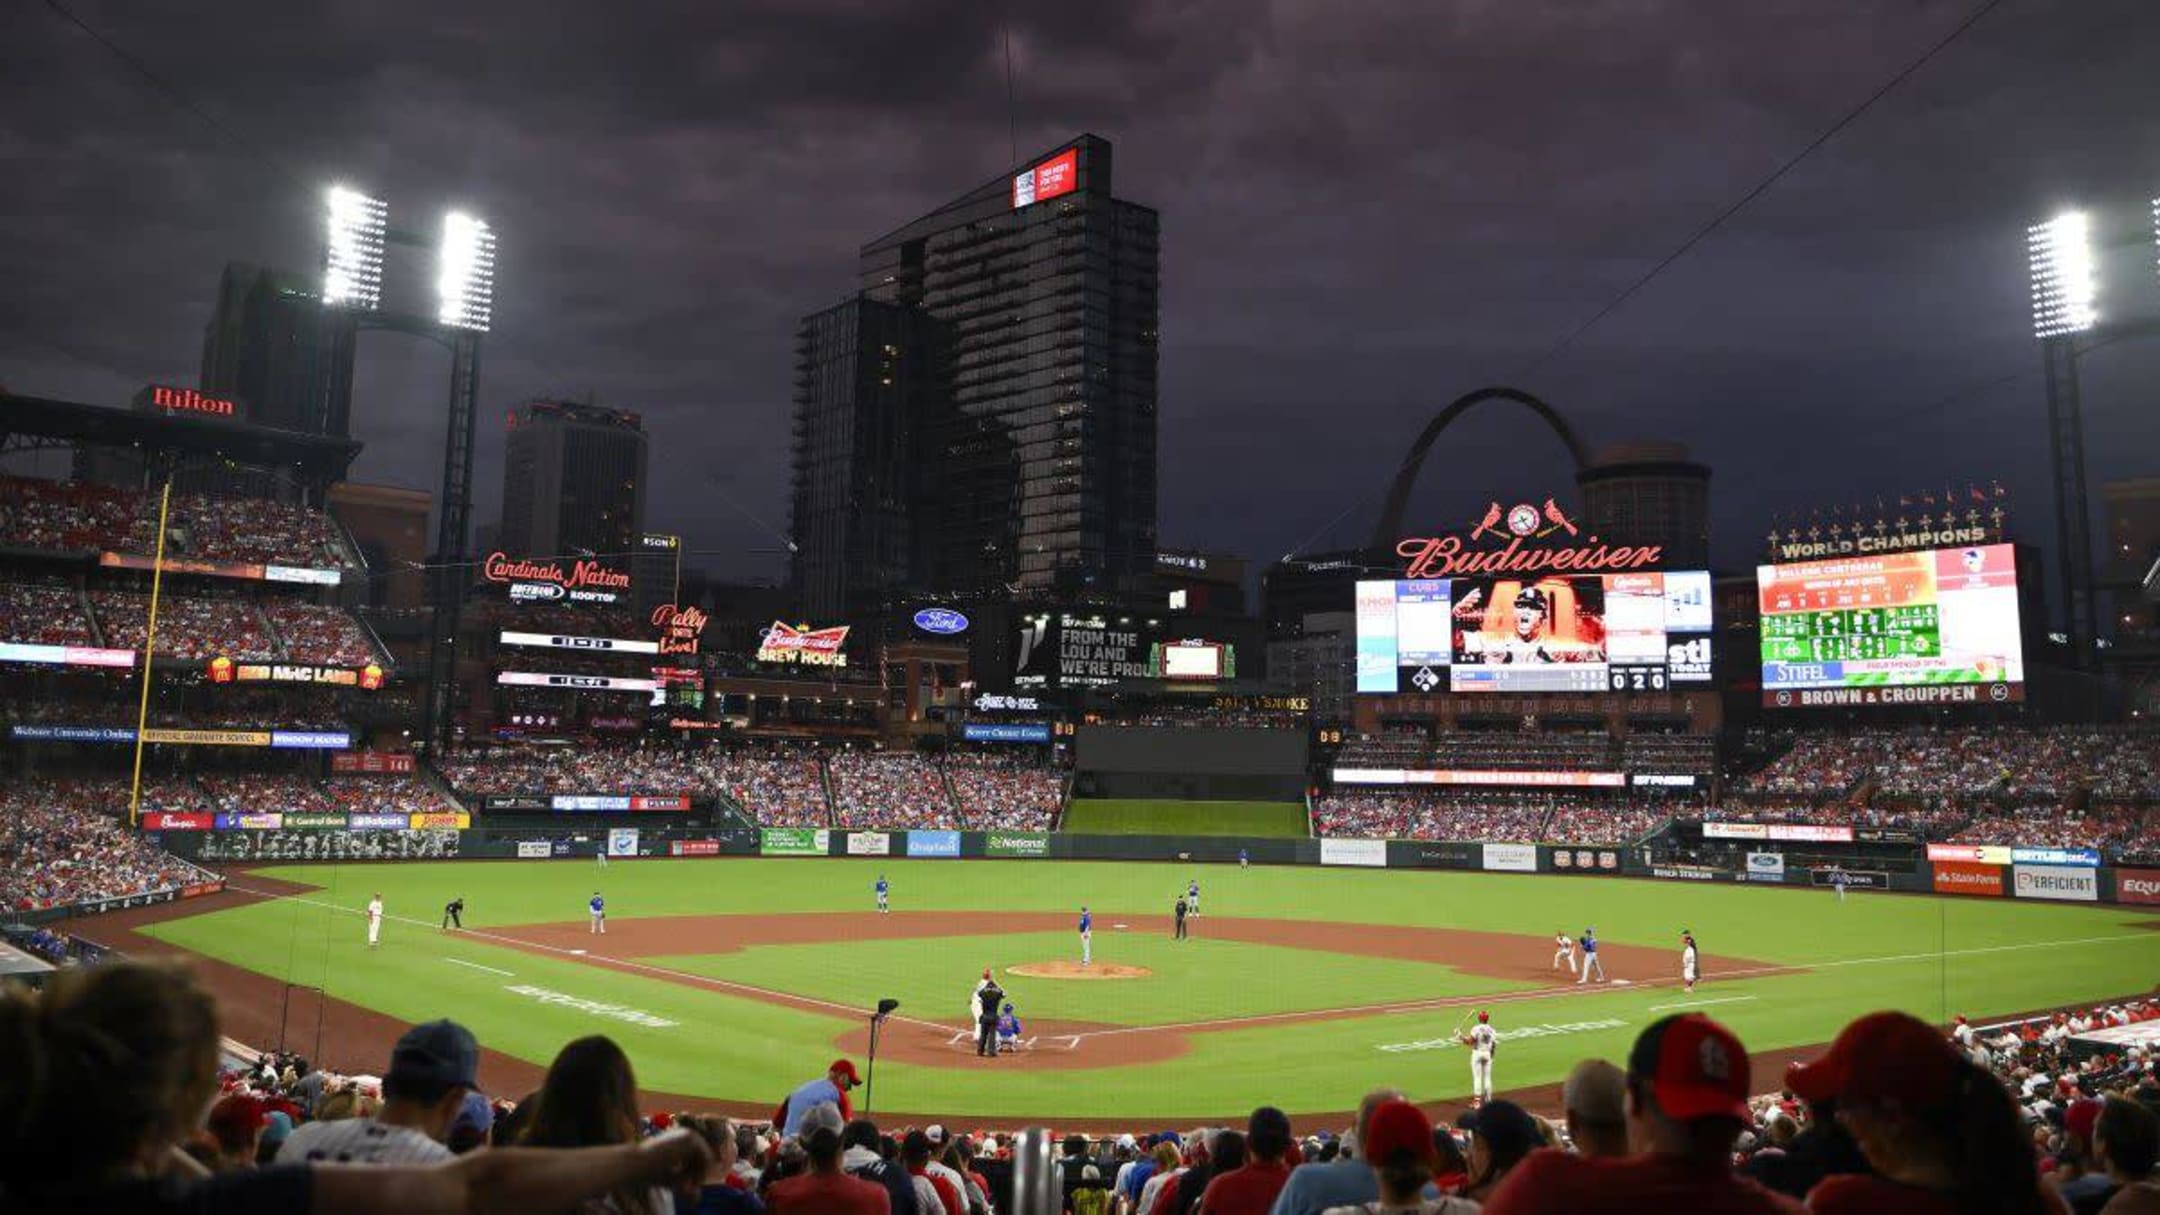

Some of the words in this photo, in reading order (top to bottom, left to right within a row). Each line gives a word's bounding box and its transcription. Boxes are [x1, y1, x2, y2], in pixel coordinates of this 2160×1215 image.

[153, 387, 234, 415] Hilton
[1782, 541, 1853, 559] WORLD
[1857, 527, 1986, 551] CHAMPIONS
[1396, 536, 1664, 579] Budweiser
[485, 552, 564, 582] Cardinals
[563, 560, 630, 588] Nation
[570, 590, 616, 602] ROOFTOP
[922, 613, 961, 630] Ford
[1061, 629, 1104, 646] FROM
[1109, 632, 1138, 647] THE
[757, 647, 797, 663] BREW
[800, 651, 847, 667] HOUSE
[1060, 645, 1091, 660] LOU
[1094, 647, 1126, 662] AND
[1668, 637, 1712, 664] stl
[236, 664, 271, 680] BIG
[313, 669, 358, 685] LAND
[1060, 660, 1109, 676] WE'RE
[1111, 662, 1151, 677] PROU
[1670, 663, 1711, 673] TODAY
[1777, 664, 1828, 682] STIFEL
[1612, 674, 1625, 689] 0
[1633, 674, 1645, 689] 2
[1652, 674, 1664, 689] 0
[1801, 688, 1862, 706] BROWN
[1866, 691, 1877, 703] &
[1881, 685, 1975, 704] CROUPPEN
[13, 725, 51, 737] Webster
[54, 727, 101, 741] University
[103, 728, 135, 740] Online
[273, 733, 313, 744] WINDOW
[314, 735, 349, 746] NATION
[1001, 837, 1047, 849] National
[1950, 872, 1976, 884] State
[1976, 874, 2000, 886] Farm
